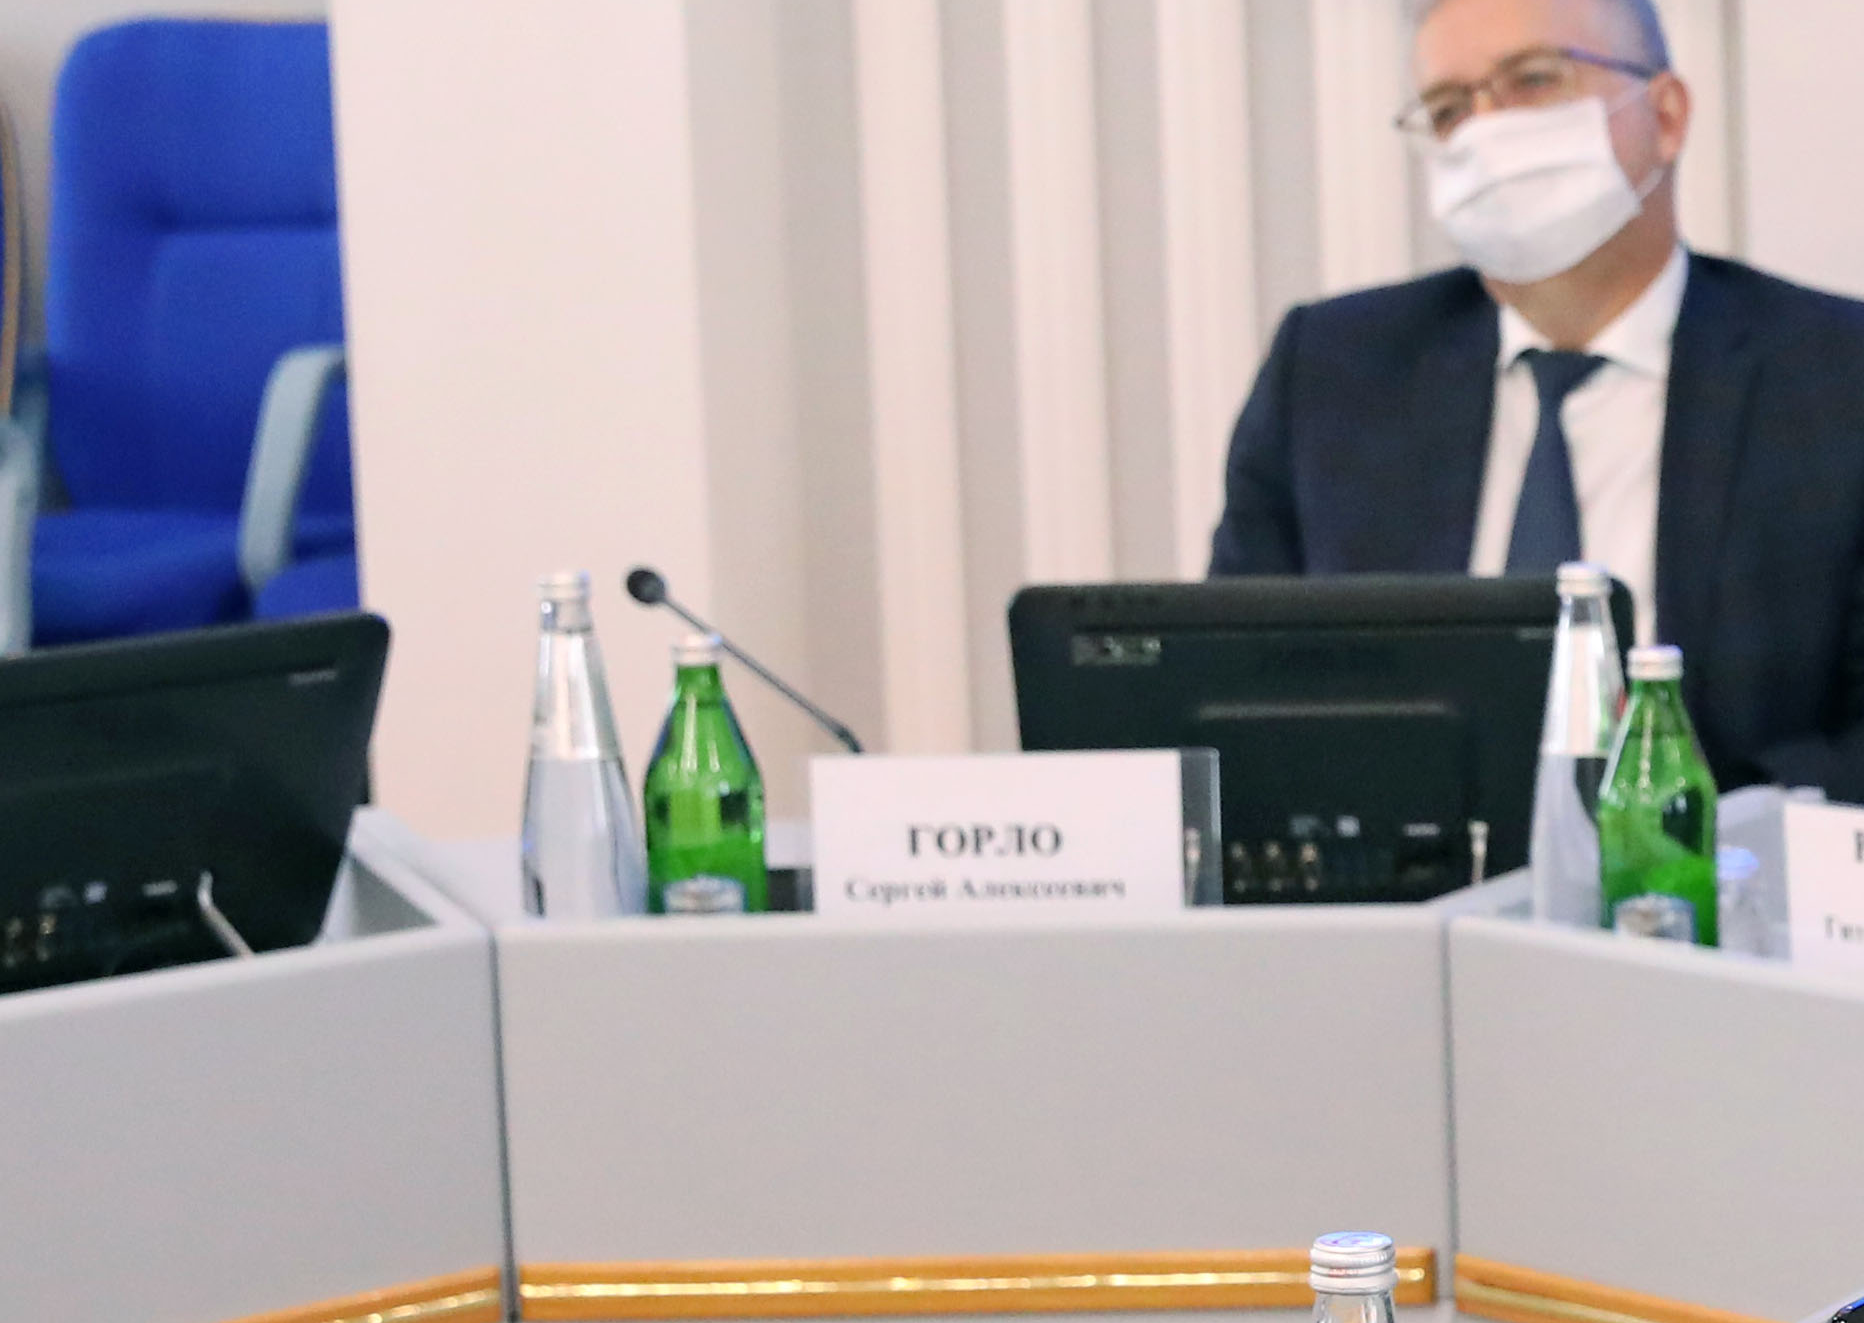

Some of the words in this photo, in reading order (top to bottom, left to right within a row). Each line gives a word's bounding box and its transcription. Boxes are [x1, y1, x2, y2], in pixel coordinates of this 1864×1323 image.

[906, 822, 1063, 858] ГОРЛО
[845, 878, 948, 906] Сергей
[960, 878, 1126, 900] Алексеевич
